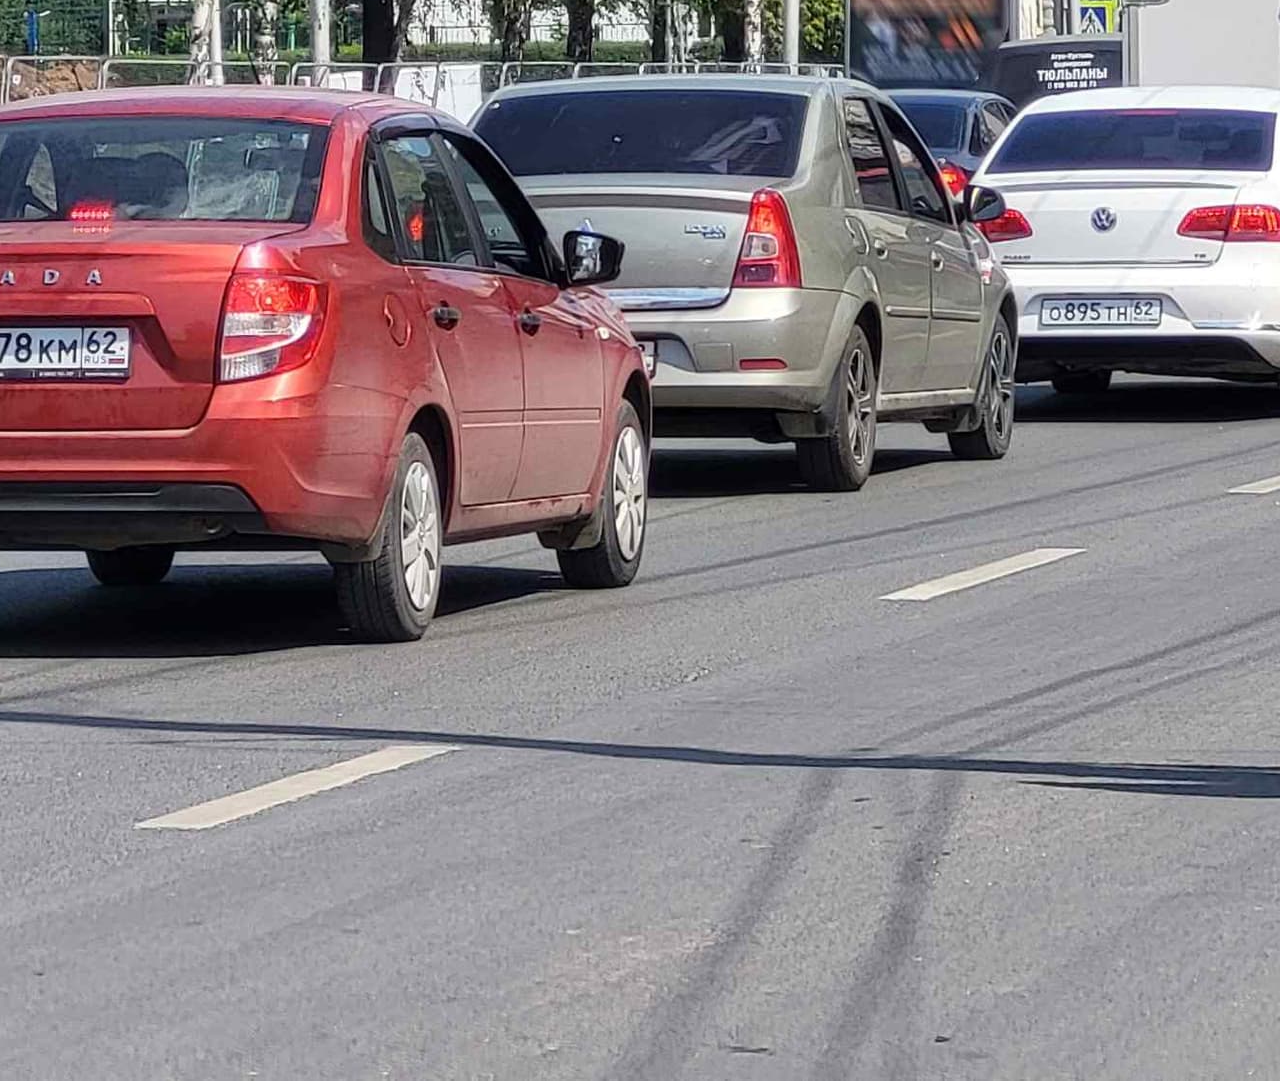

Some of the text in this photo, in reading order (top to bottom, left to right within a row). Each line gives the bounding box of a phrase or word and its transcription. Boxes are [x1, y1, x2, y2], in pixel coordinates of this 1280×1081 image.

[1036, 67, 1108, 82] ТЮЛЬПАНЫ
[1049, 301, 1153, 321] О895ТН 62
[86, 330, 118, 355] 62
[84, 355, 107, 364] RUS
